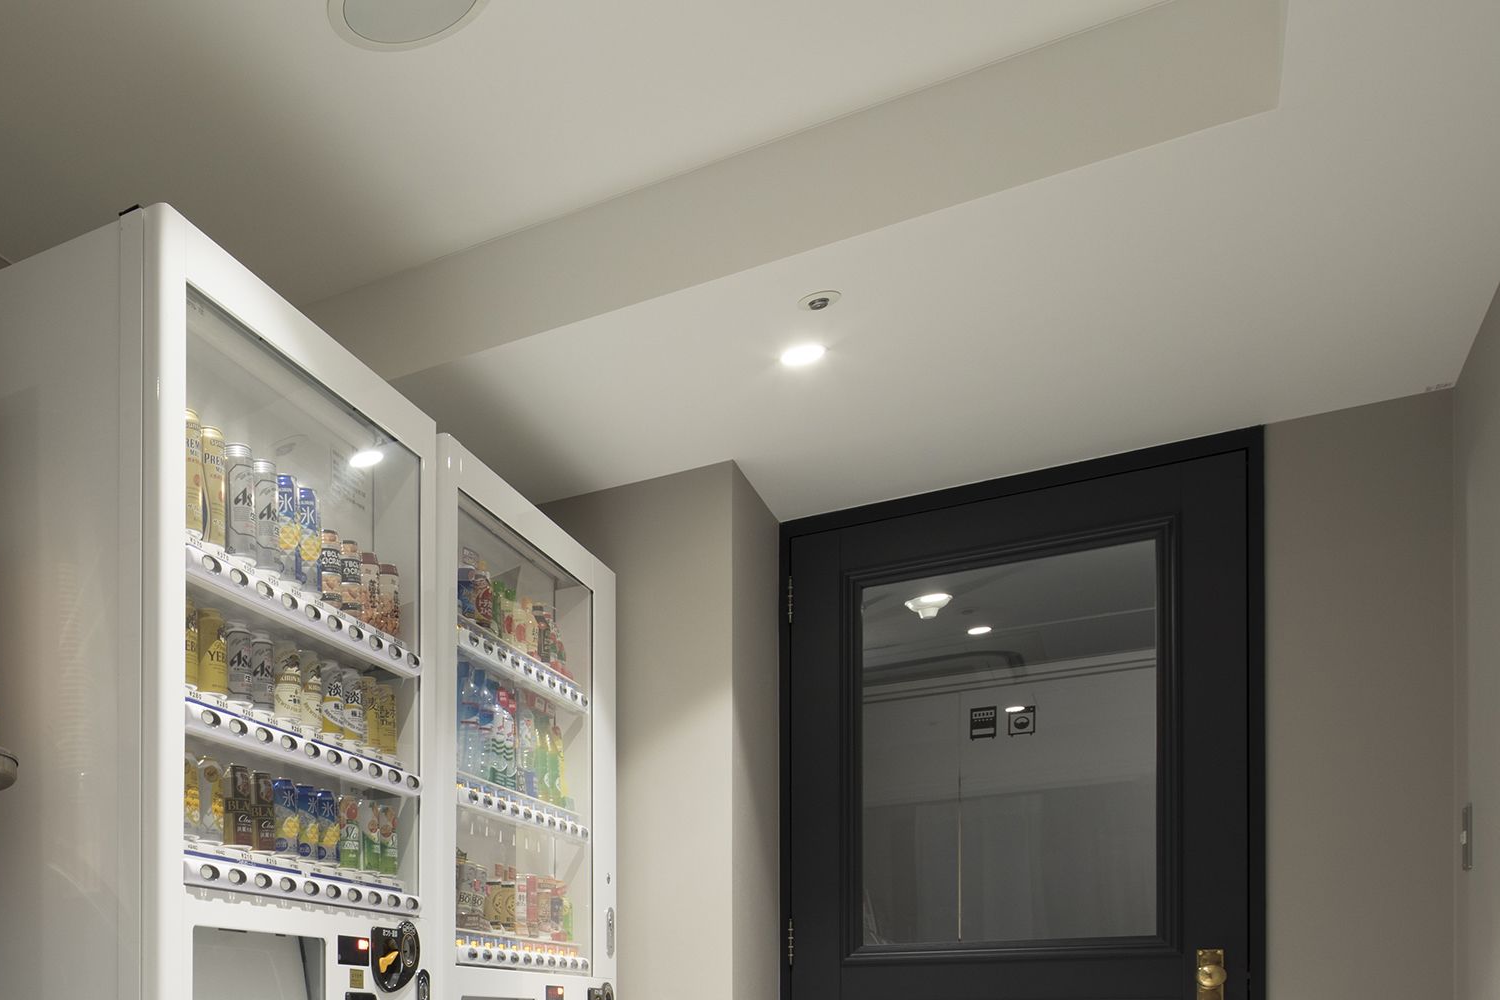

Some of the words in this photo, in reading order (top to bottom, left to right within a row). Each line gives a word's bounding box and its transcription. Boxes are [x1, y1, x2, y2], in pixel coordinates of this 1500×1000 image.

[278, 492, 293, 514] 氷
[300, 506, 315, 526] 氷
[282, 791, 295, 807] 氷
[307, 797, 318, 814] 氷
[321, 801, 334, 818] 氷
